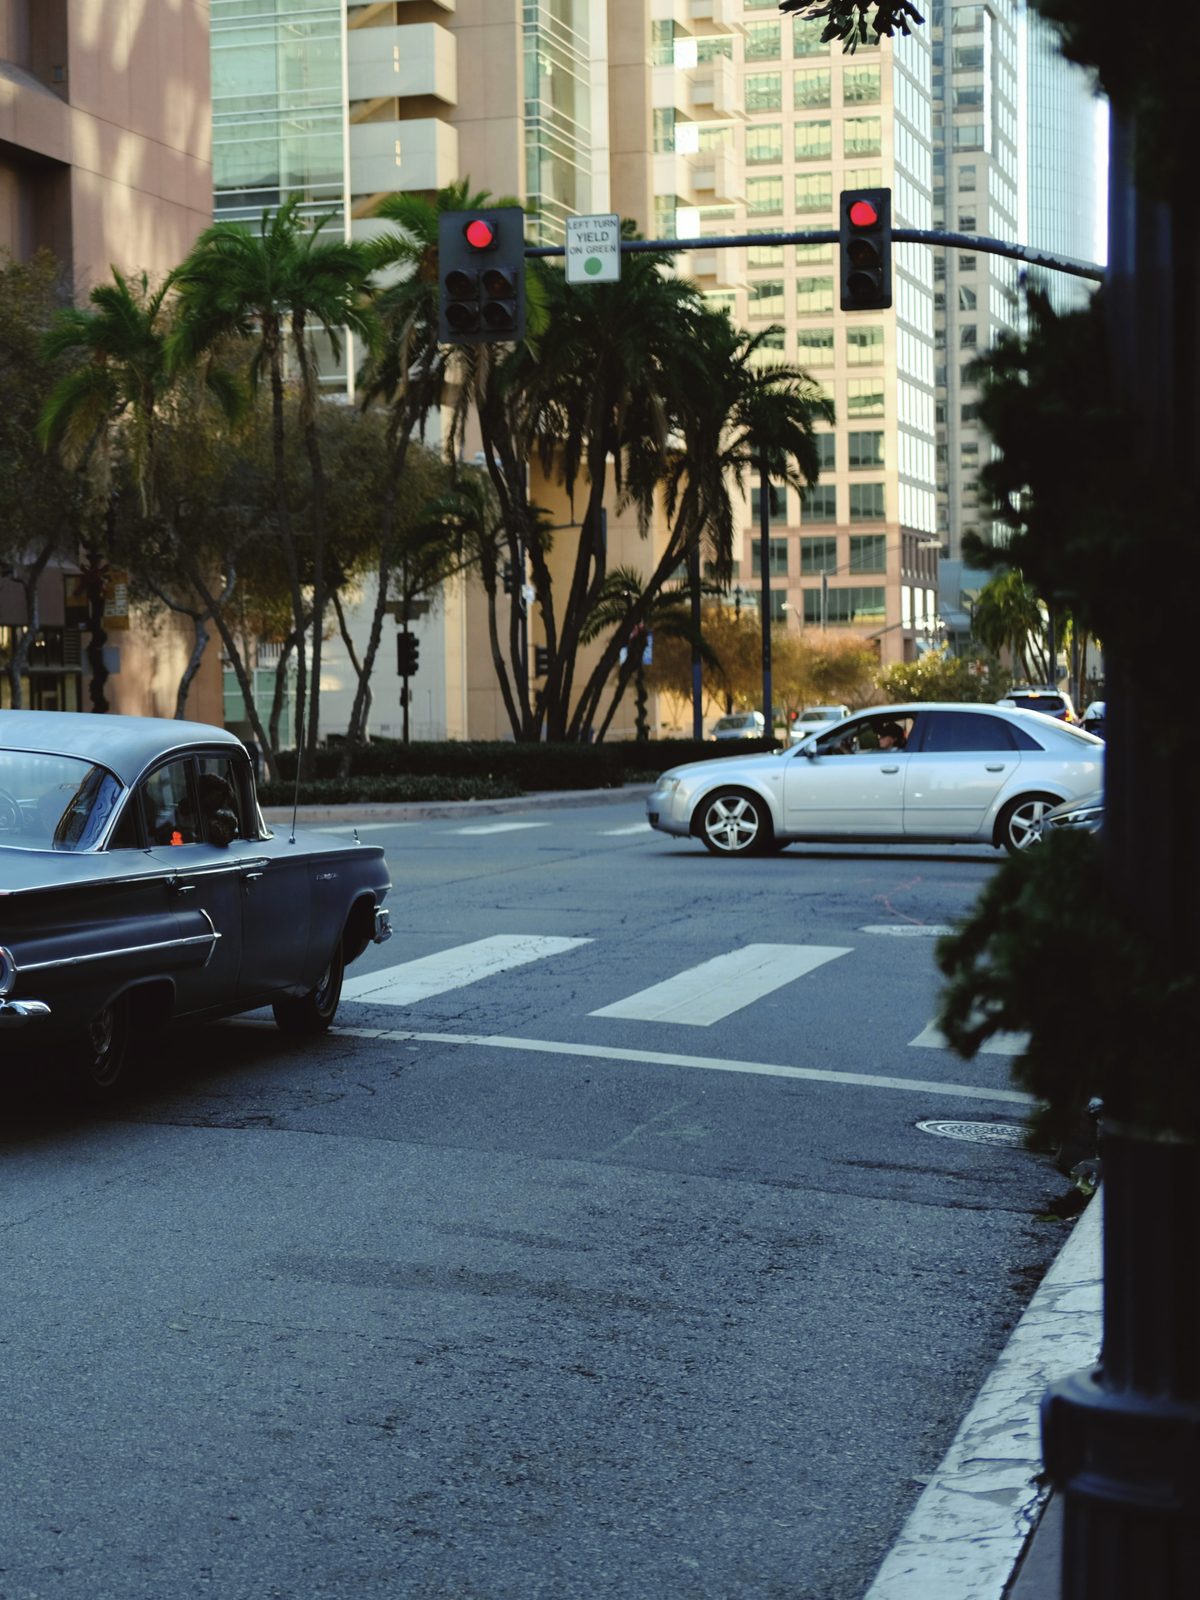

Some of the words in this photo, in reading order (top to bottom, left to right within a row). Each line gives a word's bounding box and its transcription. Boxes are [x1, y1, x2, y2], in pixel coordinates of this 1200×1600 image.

[568, 221, 589, 230] LEFT
[593, 220, 616, 228] TURN
[577, 231, 609, 242] YIELD
[569, 246, 583, 255] ON
[586, 244, 616, 254] GREEN
